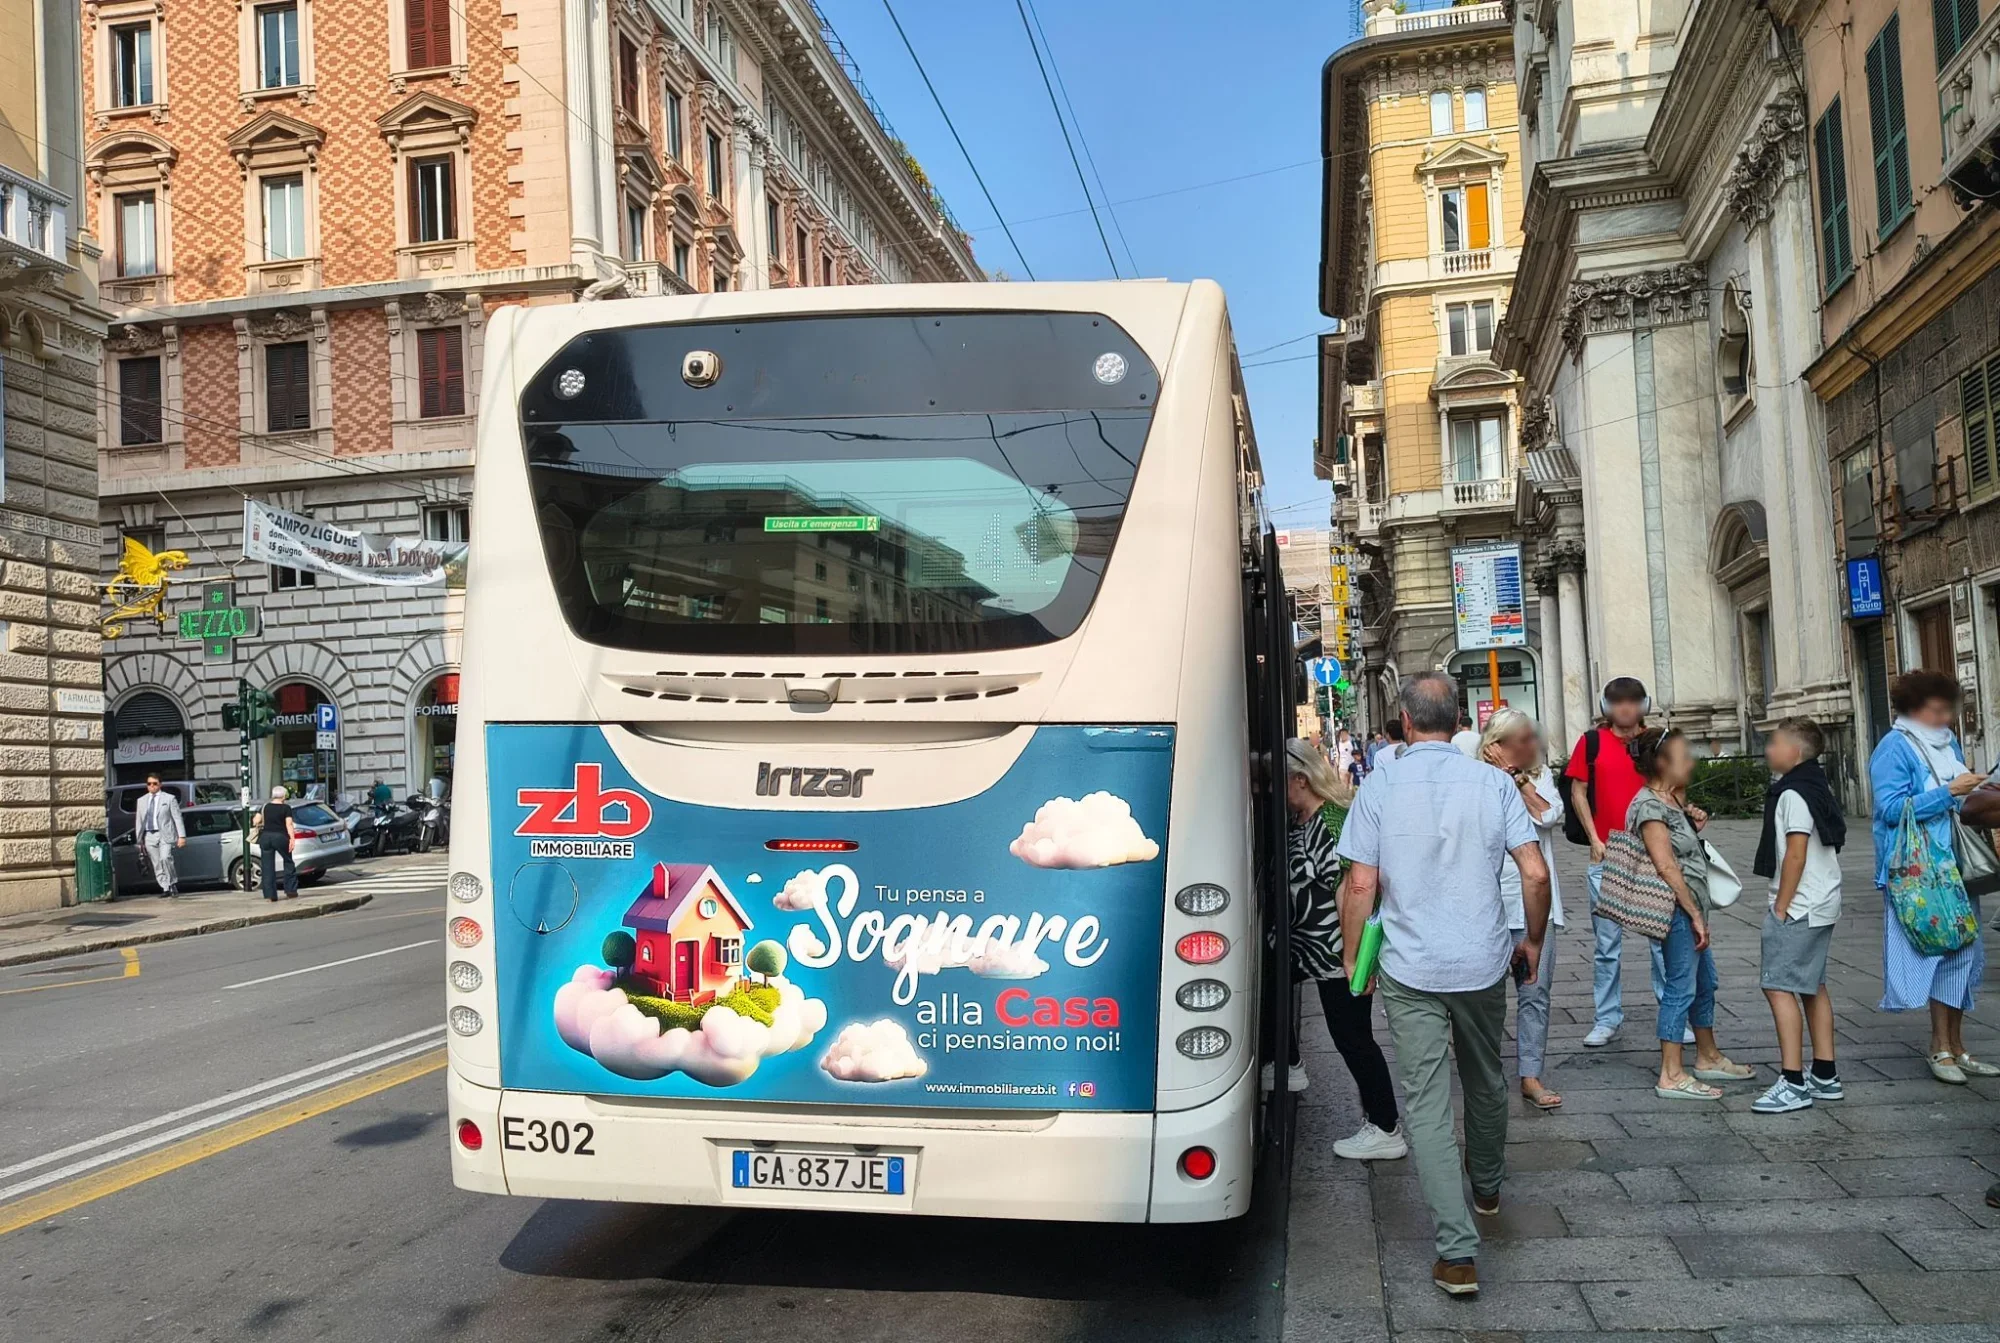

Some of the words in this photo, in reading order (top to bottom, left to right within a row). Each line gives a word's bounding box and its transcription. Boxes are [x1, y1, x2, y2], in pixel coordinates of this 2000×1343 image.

[266, 512, 310, 535] CAMPO
[310, 526, 358, 548] LIGURE
[771, 520, 799, 529] Uscita
[269, 542, 277, 551] 15
[278, 544, 303, 557] giugno
[367, 548, 393, 568] nel
[397, 547, 441, 577] borgo
[1469, 664, 1514, 677] DOUAS
[62, 691, 101, 703] FARMACIA
[321, 706, 334, 728] P
[415, 704, 459, 717] FORME
[140, 741, 181, 756] Pasticceria
[515, 763, 652, 838] zb
[532, 842, 633, 858] IMMOBILIARE
[875, 885, 899, 902] Tu
[906, 888, 967, 905] pensa
[973, 889, 985, 902] a
[788, 863, 1109, 1005] Sognare
[916, 993, 983, 1026] alla
[995, 988, 1120, 1027] Casa
[917, 1029, 938, 1048] ci
[945, 1031, 1068, 1053] pensiamo
[1076, 1032, 1121, 1051] noi!
[925, 1082, 1057, 1095] www.immobiliarezb.it
[504, 1116, 595, 1155] E302
[754, 1155, 785, 1185] GA
